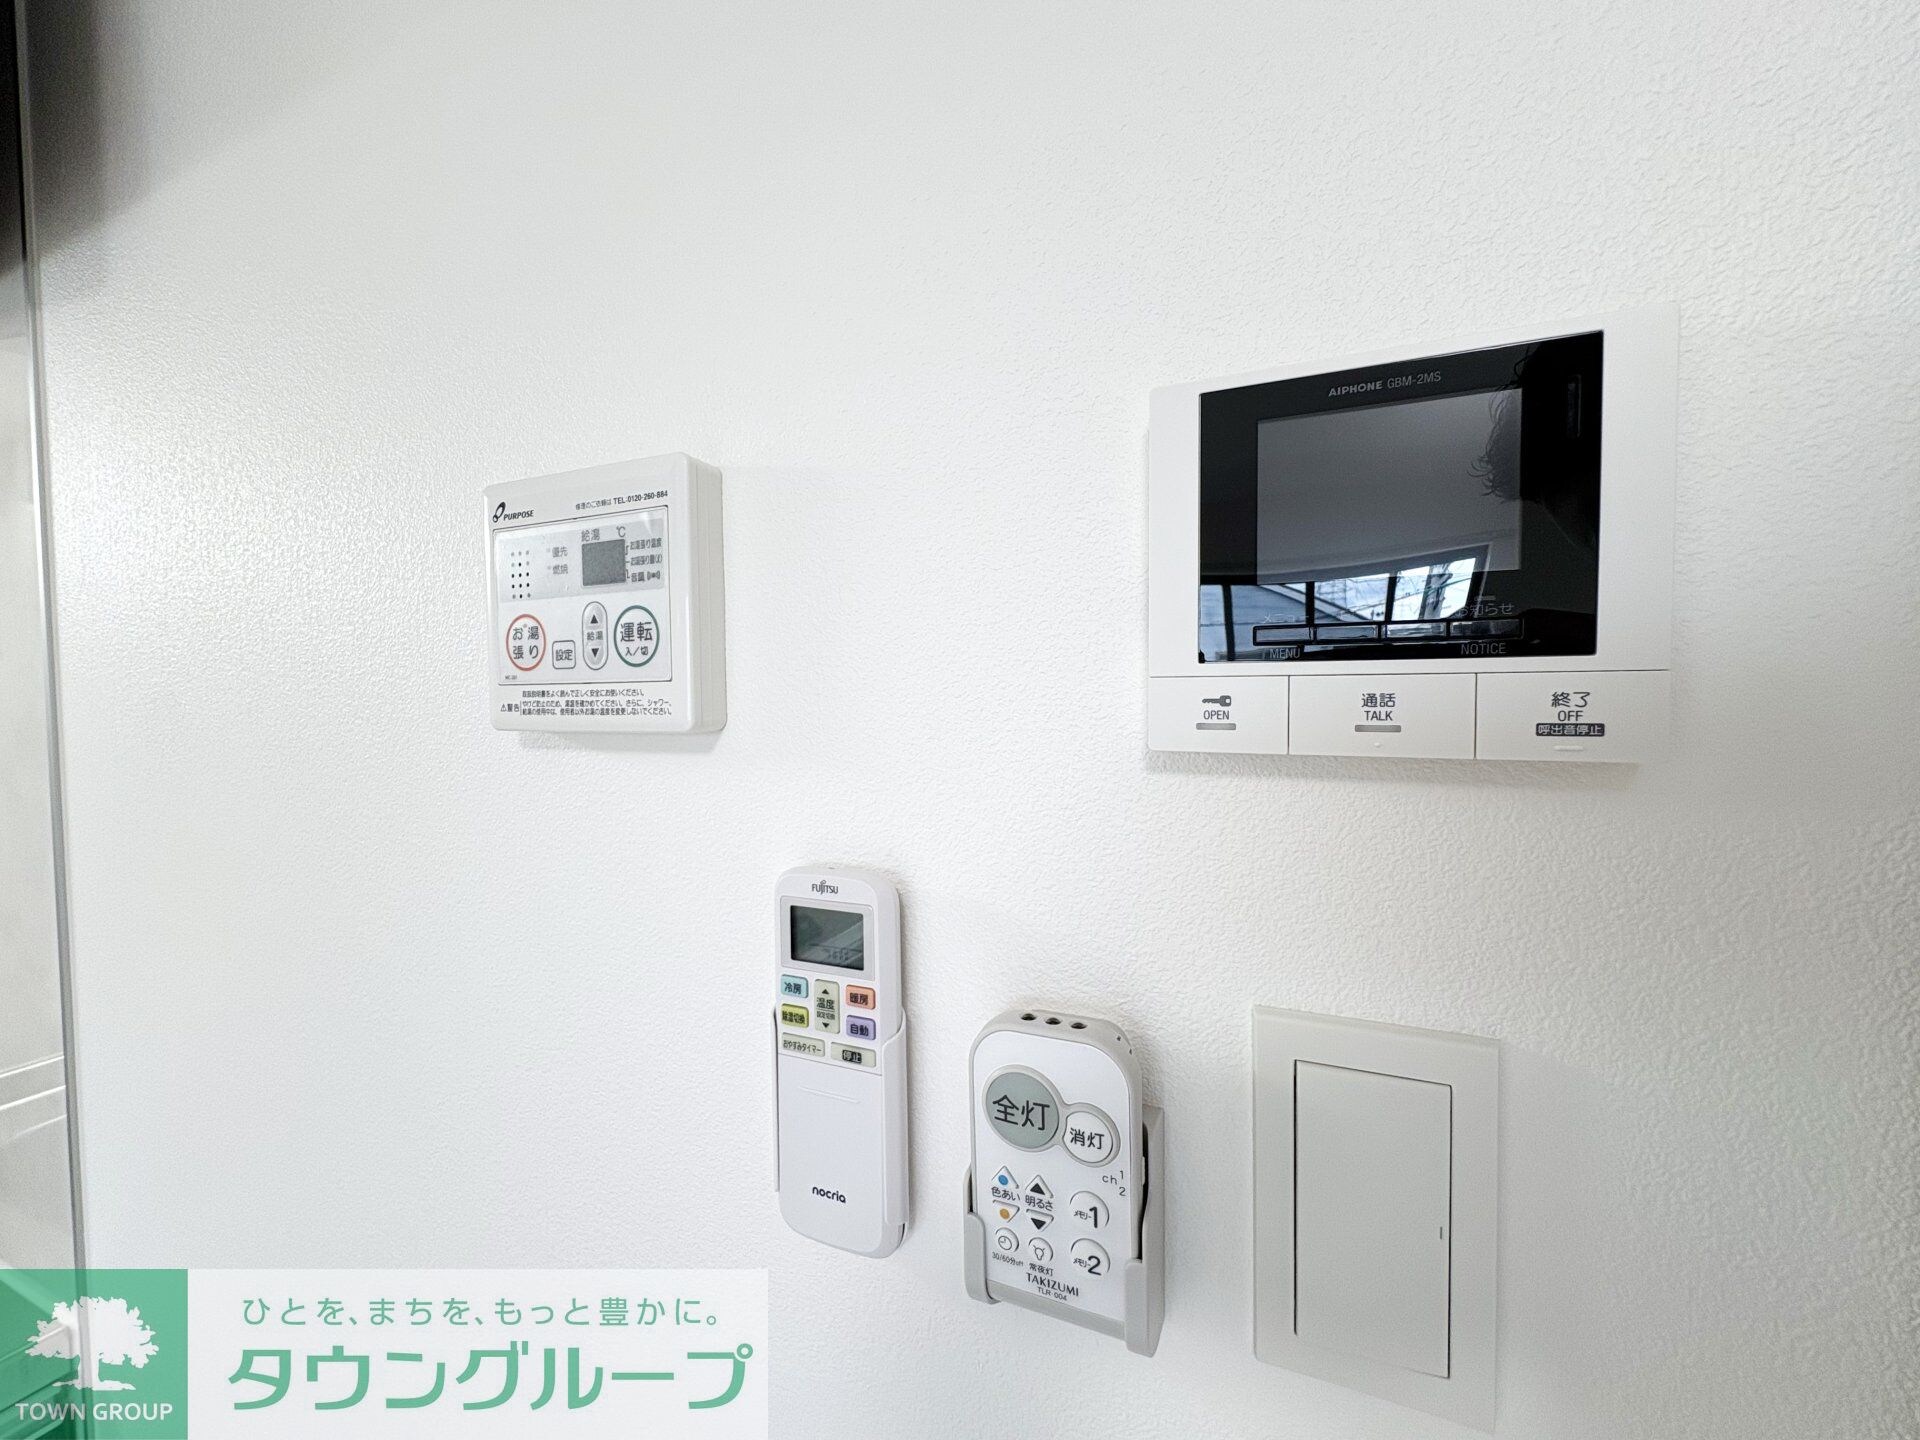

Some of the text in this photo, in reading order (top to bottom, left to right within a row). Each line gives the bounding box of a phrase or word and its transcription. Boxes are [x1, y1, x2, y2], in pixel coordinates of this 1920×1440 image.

[1328, 371, 1442, 397] AIPHONE GBM-2MS
[503, 510, 535, 521] PURPOSE
[581, 529, 600, 542] 給湯
[552, 547, 568, 558] 優先
[552, 564, 569, 575] 燃焼
[1456, 602, 1515, 617] お知らせ
[586, 630, 604, 641] 給湯
[620, 621, 654, 642] 運転
[555, 649, 573, 661] 設定
[1270, 647, 1301, 659] MENU
[1461, 642, 1507, 655] NOTICE
[1361, 691, 1396, 708] 通話
[1551, 691, 1591, 708] 終了
[1203, 710, 1230, 721] OPEN
[1364, 710, 1393, 721] TALK
[1557, 710, 1583, 722] OFF
[1538, 724, 1603, 735] 呼出音停止
[812, 880, 838, 894] FUJITSU
[784, 982, 802, 995] 冷房
[816, 997, 835, 1010] 温度
[850, 992, 869, 1006] 暖房
[850, 1024, 869, 1037] 自動
[783, 1039, 822, 1054] おやすみタイマー
[842, 1049, 862, 1063] 停止
[992, 1094, 1050, 1131] 全灯
[1070, 1127, 1105, 1150] 消灯
[1102, 1174, 1118, 1185] ch
[812, 1186, 846, 1203] nocria
[991, 1186, 1021, 1201] 色あい
[1119, 1186, 1126, 1196] 2
[1025, 1194, 1054, 1211] 明るさ
[1089, 1206, 1098, 1228] 1
[1029, 1263, 1054, 1277] 常夜灯
[1088, 1255, 1102, 1276] 2
[1026, 1272, 1079, 1296] TAKIZUMI
